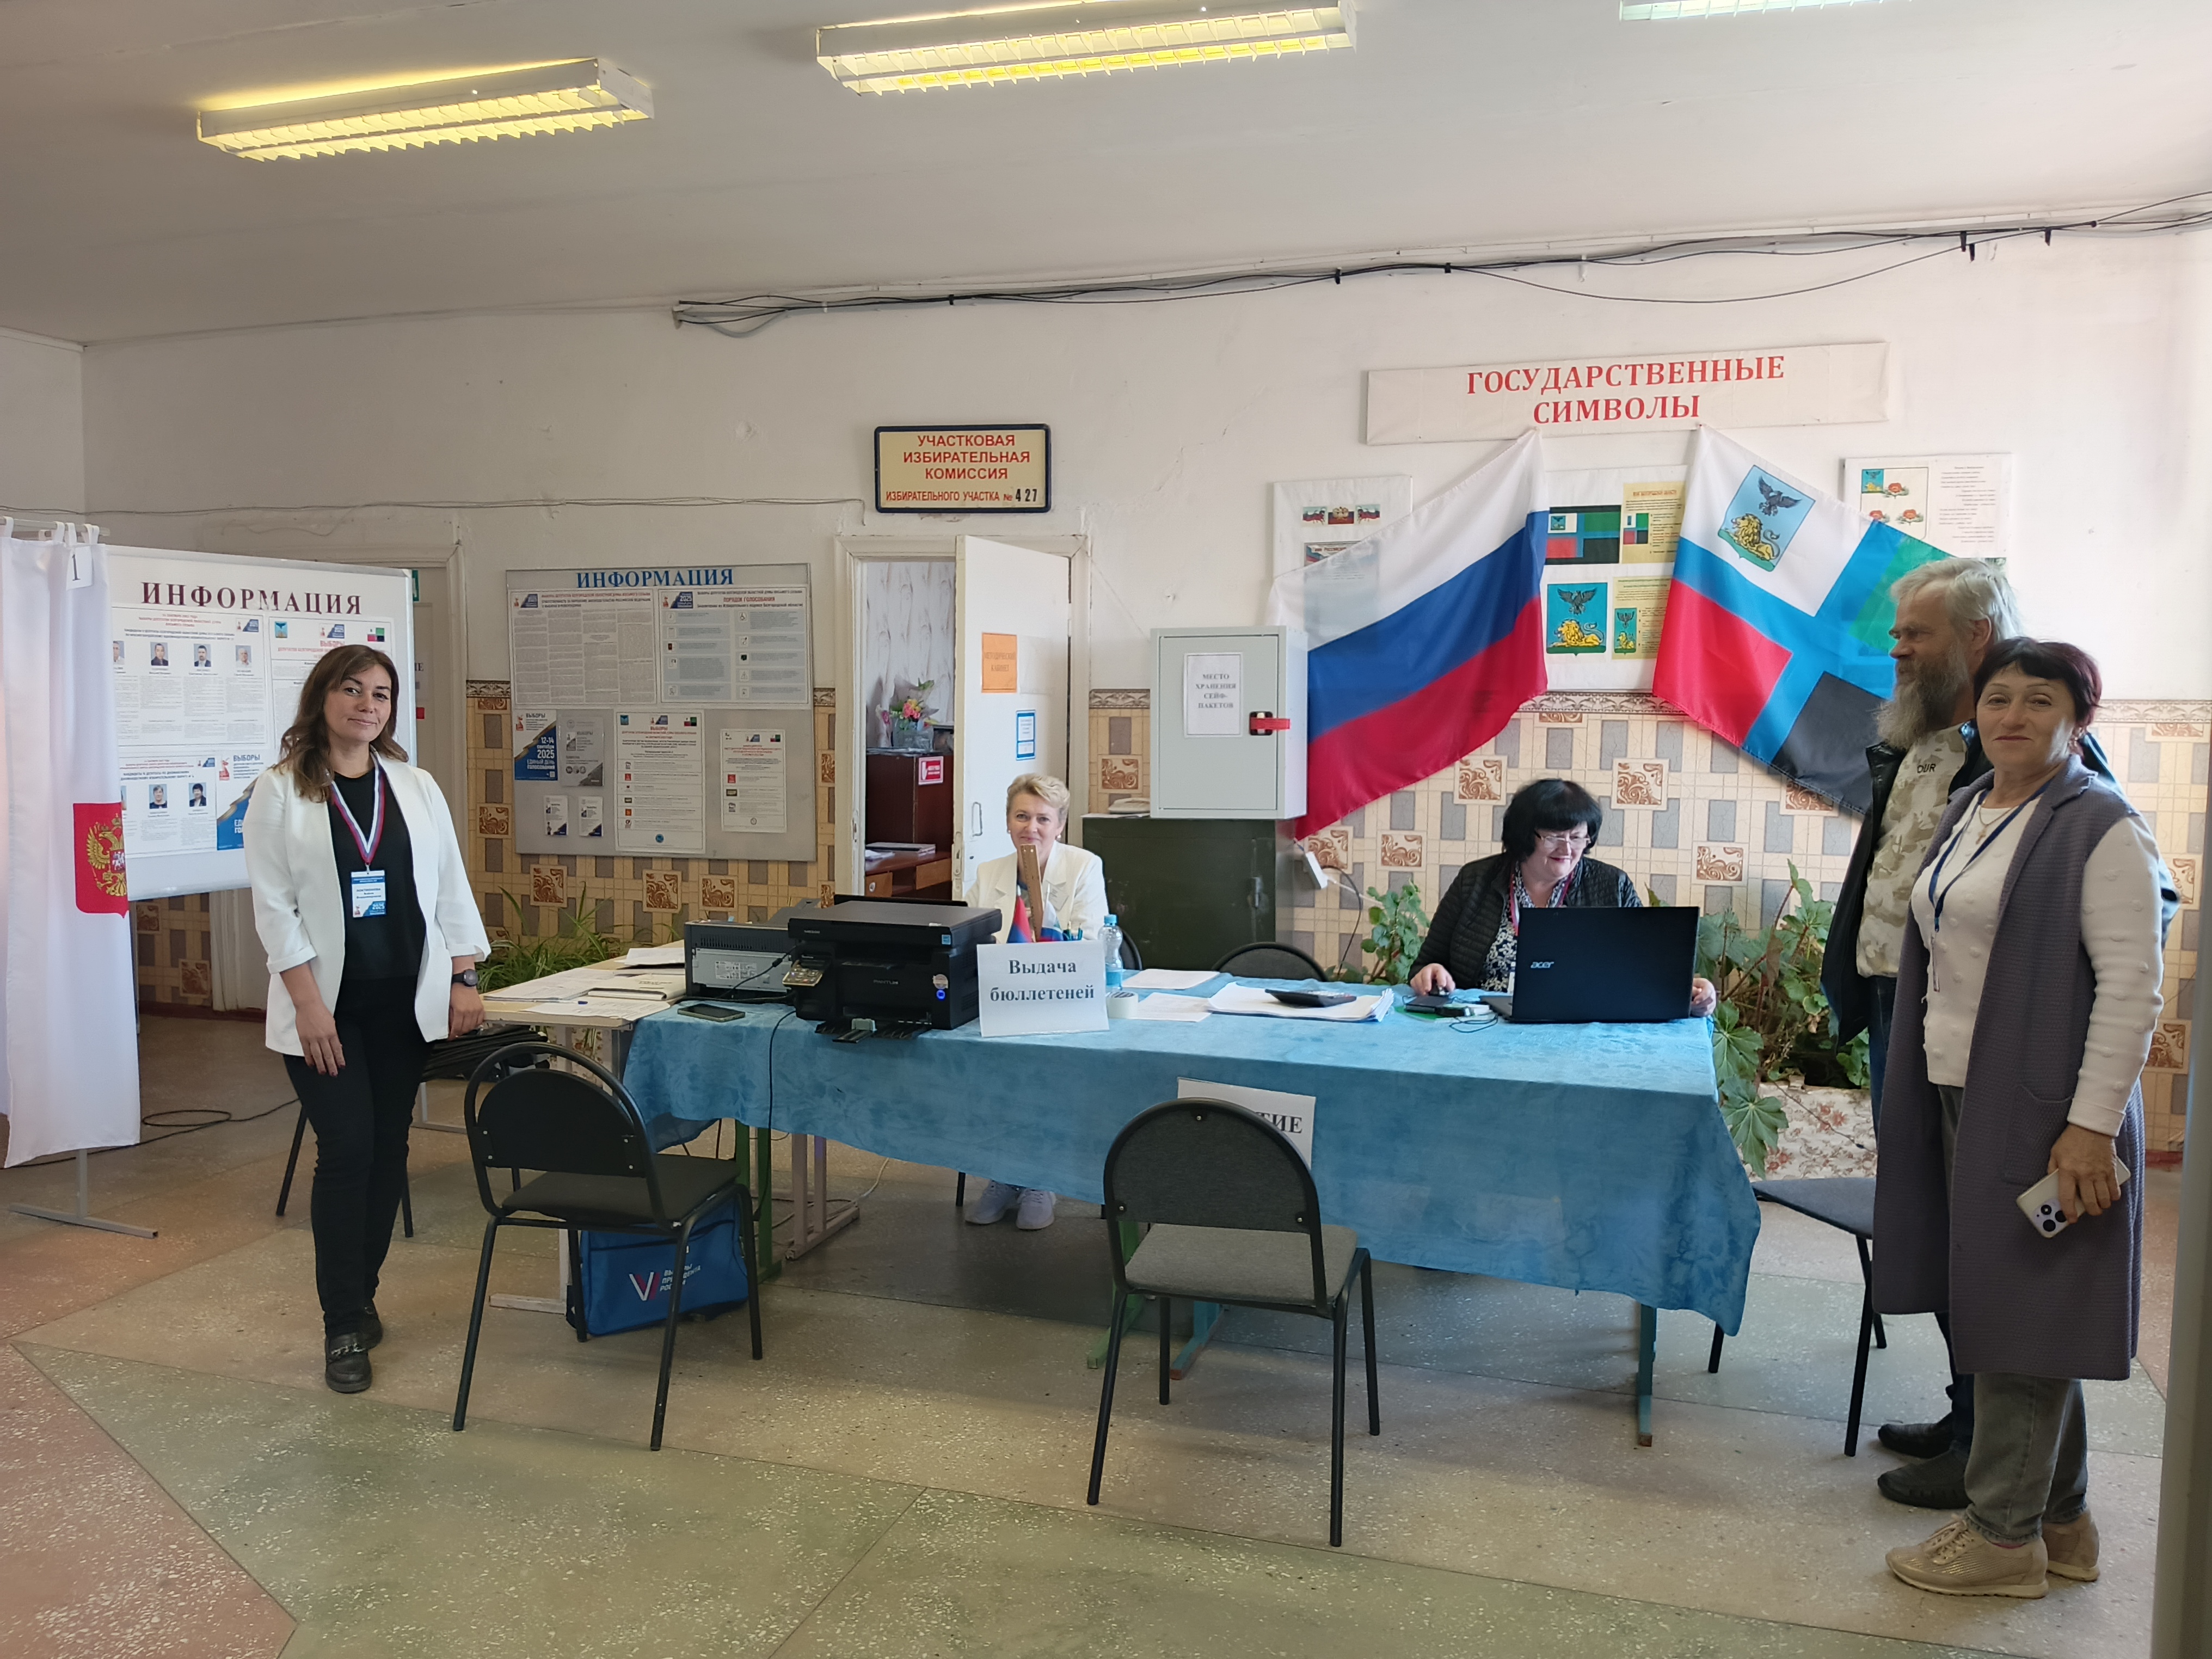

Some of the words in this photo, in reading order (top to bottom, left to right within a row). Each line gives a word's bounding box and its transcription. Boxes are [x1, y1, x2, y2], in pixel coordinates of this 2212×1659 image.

[1467, 355, 1784, 395] ГОСУДАРСТВЕННЫЕ
[1533, 395, 1700, 424] СИМВОЛЫ
[918, 434, 1015, 447] УЧАСТКОВАЯ
[903, 451, 1030, 463] ИЗБИРАТЕЛЬНАЯ
[925, 468, 1008, 480] КОМИССИЯ
[886, 490, 960, 501] ИЗБИРАТЕЛЬНОГО
[963, 491, 1000, 501] УЧАСТКА
[1015, 488, 1037, 502] 427
[72, 554, 81, 581] 1
[576, 568, 734, 588] ИНФОРМАЦИЯ
[140, 581, 363, 615] ИНФОРМАЦИЯ
[233, 754, 261, 762] ВЫБОРЫ
[537, 749, 555, 759] 2025
[1009, 959, 1077, 974] Выдача
[990, 985, 1095, 1001] бюллетеней
